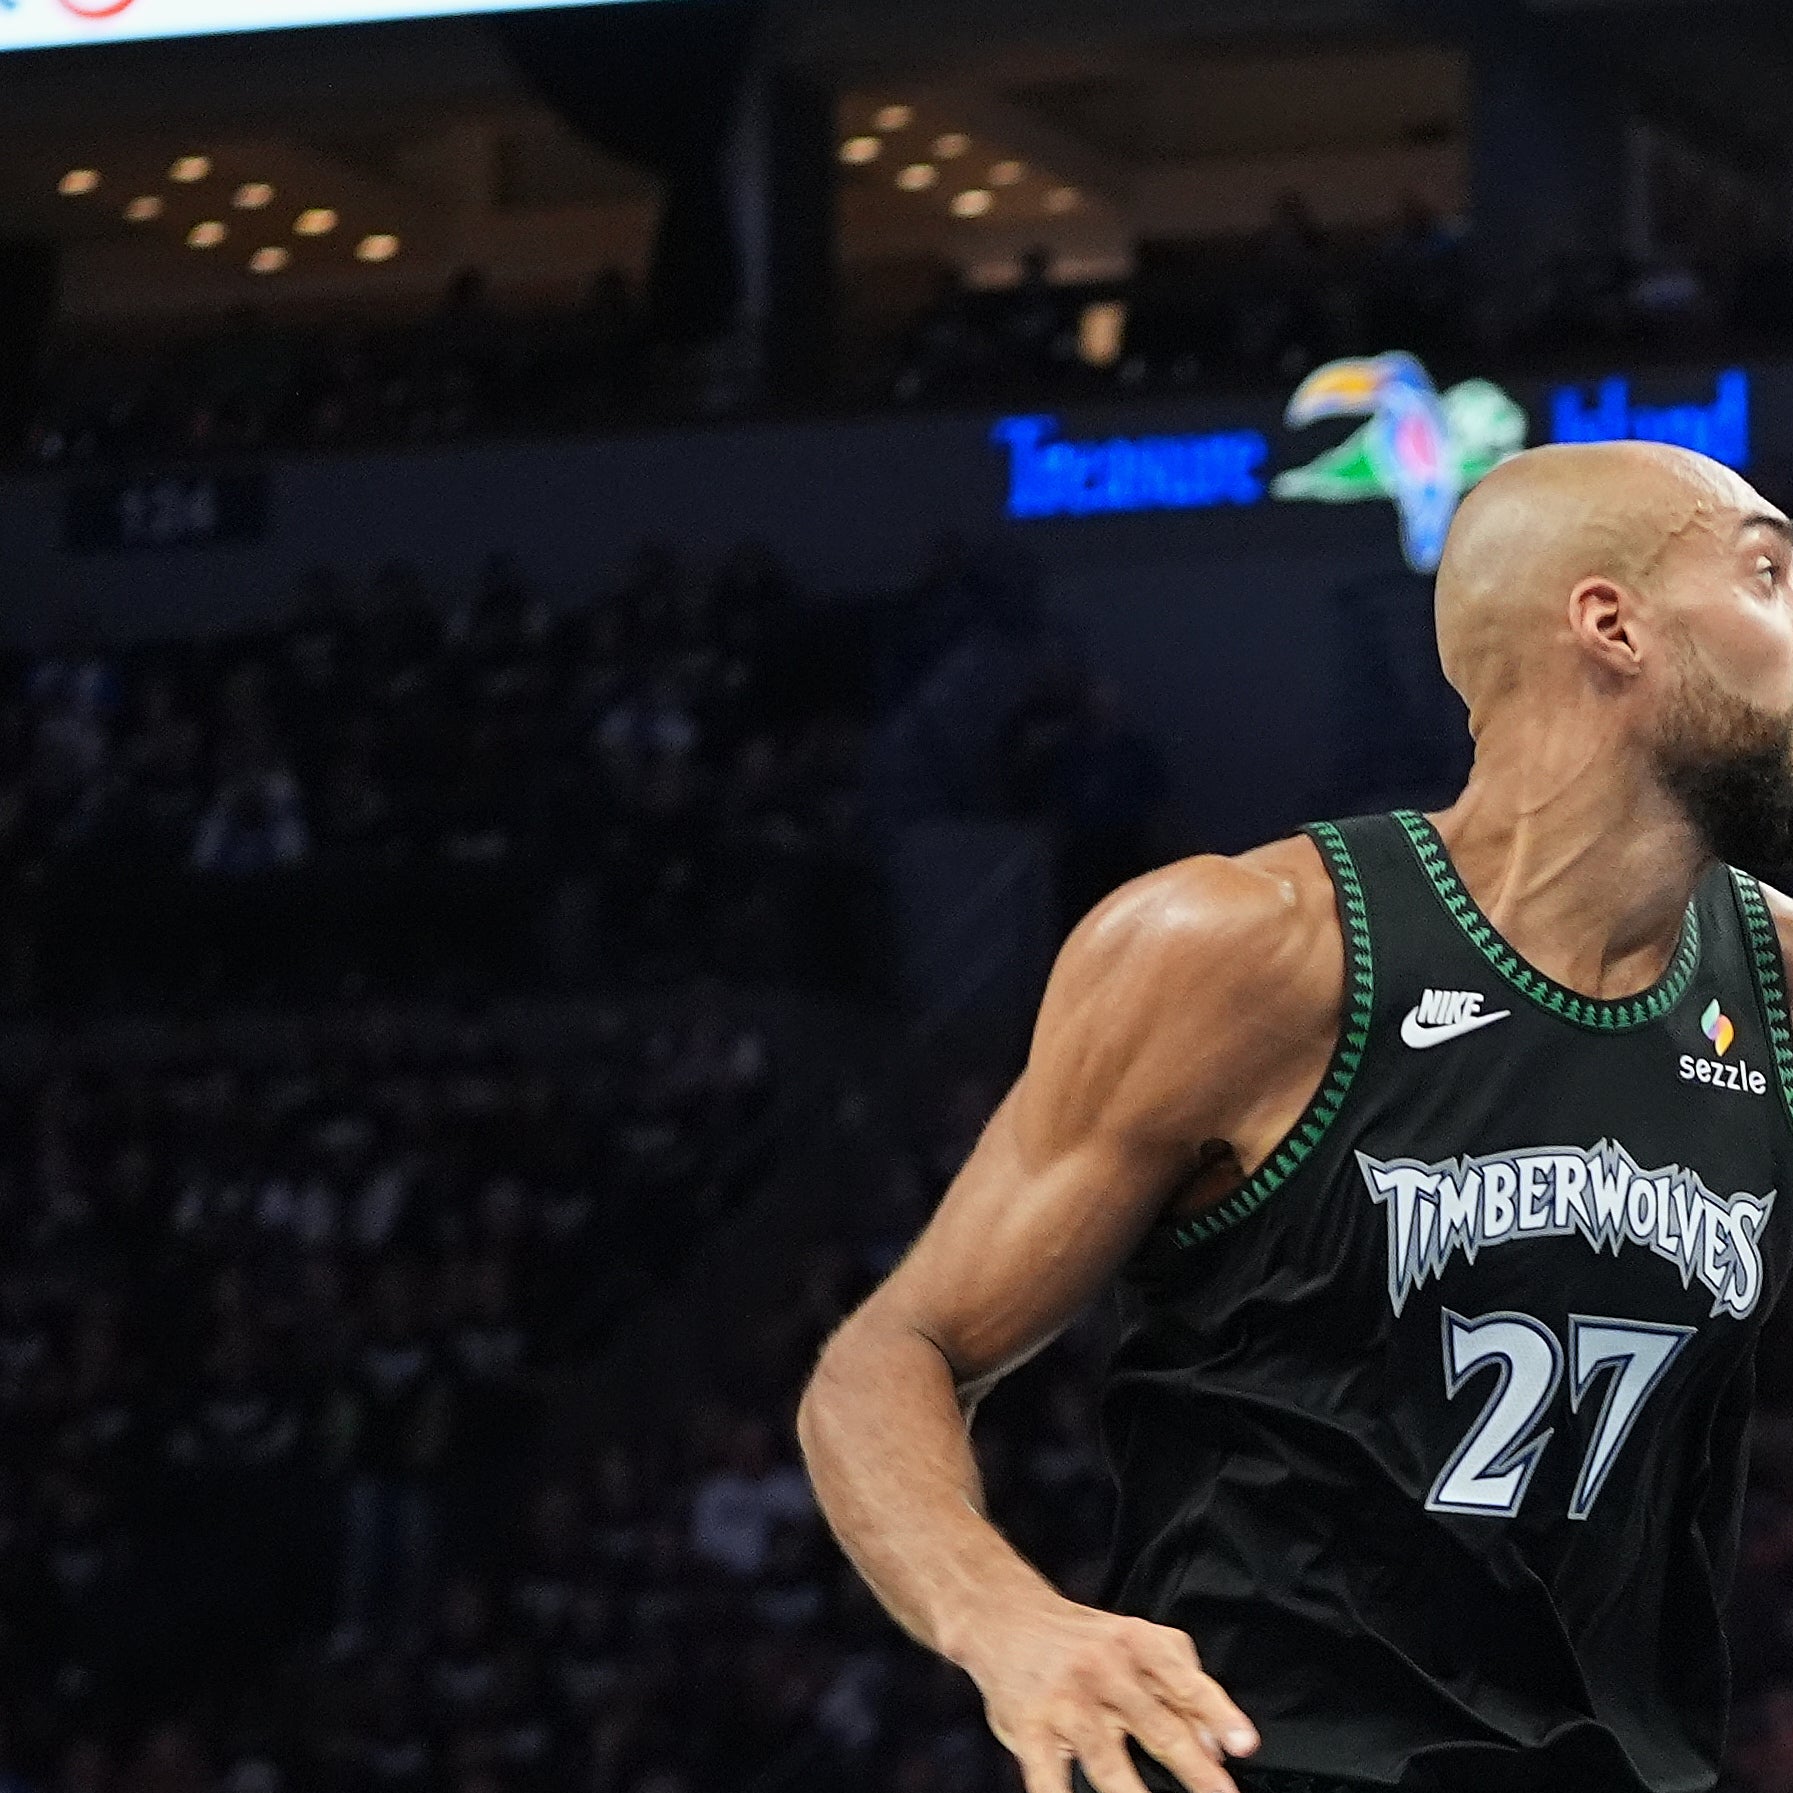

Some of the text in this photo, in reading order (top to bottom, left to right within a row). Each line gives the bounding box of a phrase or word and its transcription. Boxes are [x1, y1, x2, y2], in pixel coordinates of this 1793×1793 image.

[1417, 987, 1485, 1026] NIKE
[1678, 1053, 1768, 1096] sezzle
[1353, 1137, 1778, 1320] TIMBERWOLVES
[1423, 1305, 1699, 1521] 27
